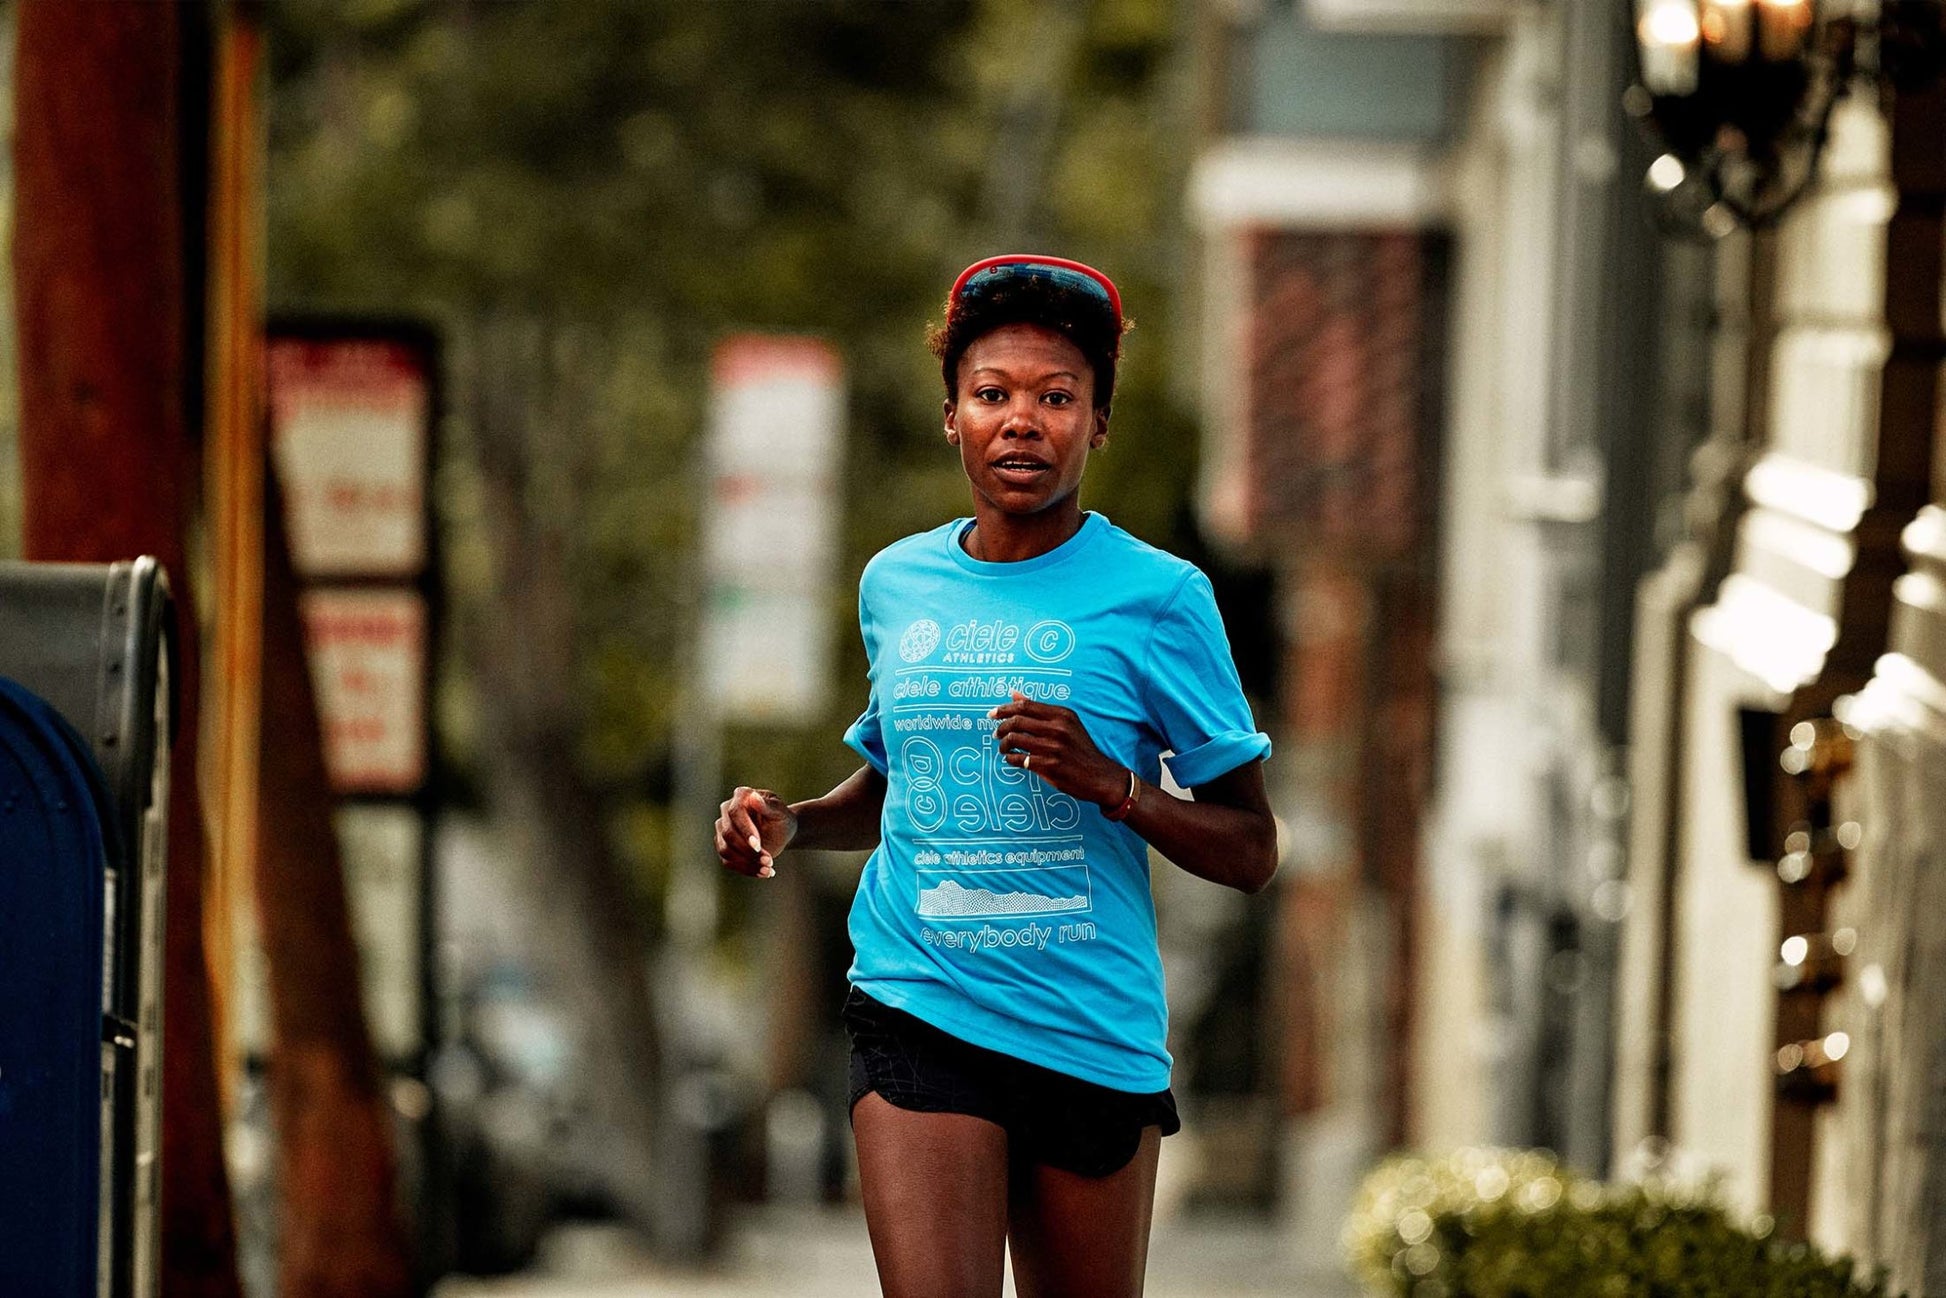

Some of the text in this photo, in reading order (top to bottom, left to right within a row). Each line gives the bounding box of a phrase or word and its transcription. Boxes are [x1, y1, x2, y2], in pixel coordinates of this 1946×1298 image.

[946, 619, 1019, 652] ciele
[943, 652, 1015, 664] ATHLETICS
[893, 675, 1071, 701] ciele athlétique
[894, 714, 973, 732] worldwide
[943, 849, 1003, 866] athletics
[1005, 846, 1085, 866] equipment
[920, 921, 1096, 954] everybody run
